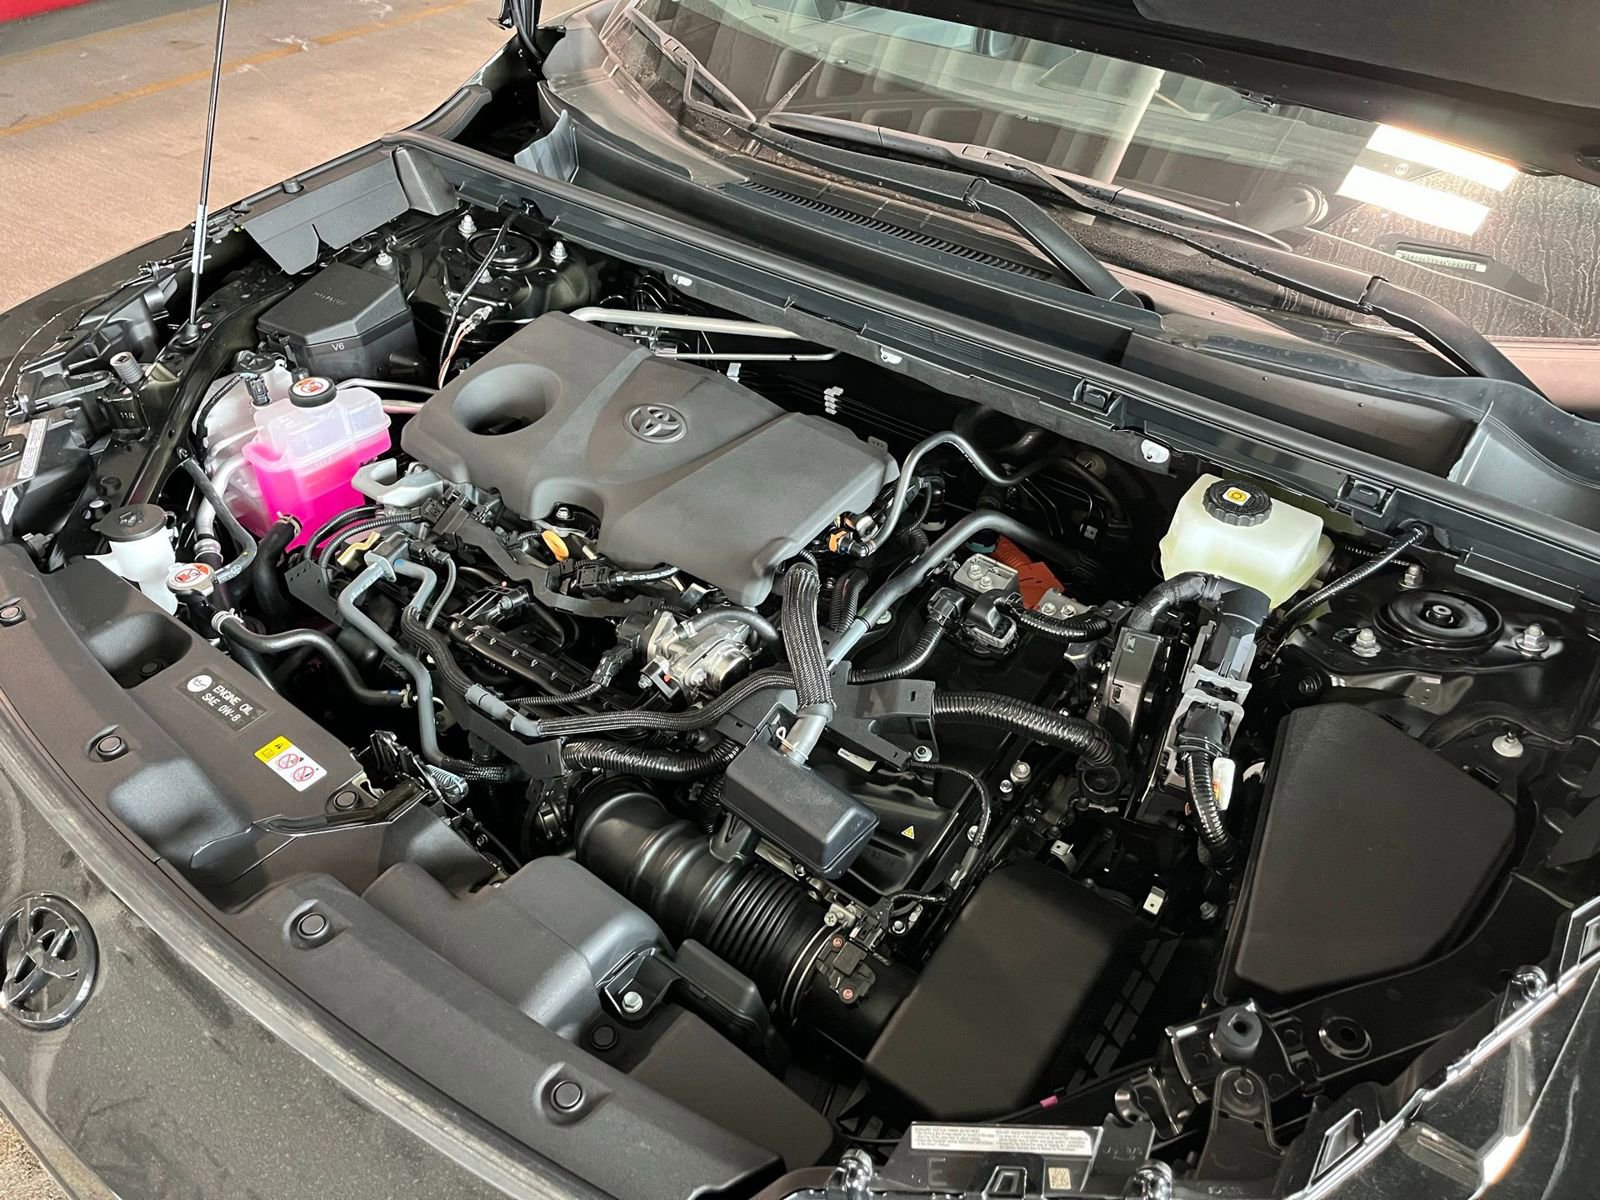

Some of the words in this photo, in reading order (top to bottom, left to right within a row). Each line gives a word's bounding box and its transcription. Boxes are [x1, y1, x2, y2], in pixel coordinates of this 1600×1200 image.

[201, 693, 220, 706] SAE
[212, 685, 241, 705] ENGINE
[239, 703, 253, 715] OIL
